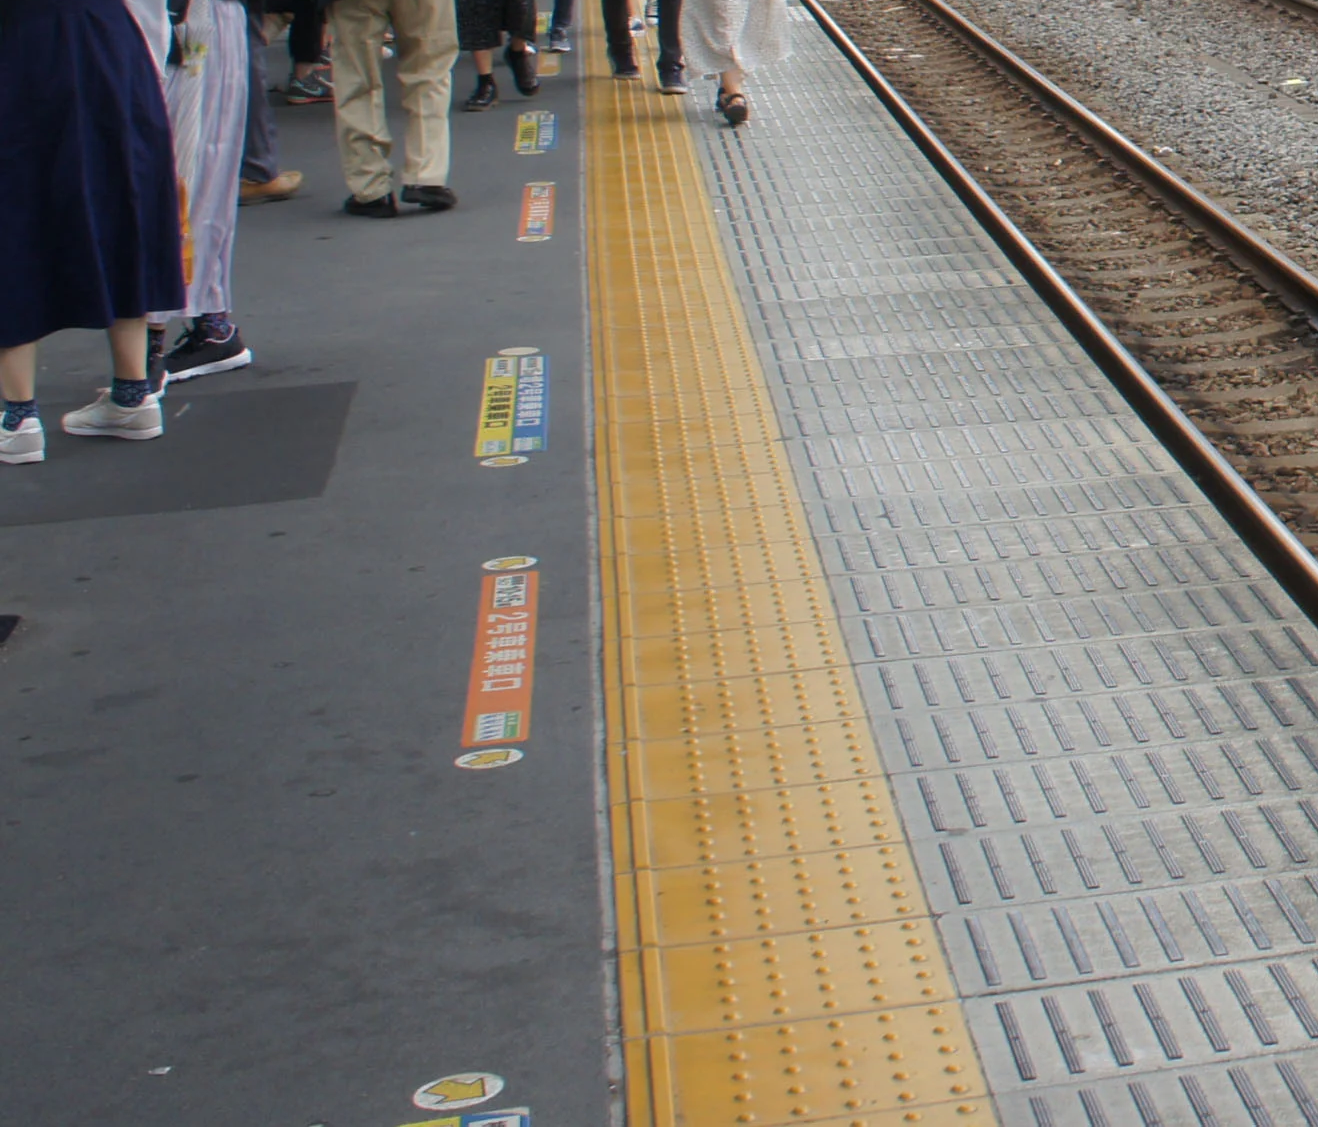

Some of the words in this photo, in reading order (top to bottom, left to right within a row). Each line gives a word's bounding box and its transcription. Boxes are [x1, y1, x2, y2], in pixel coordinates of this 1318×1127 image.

[480, 611, 529, 692] 2号車乗車口
